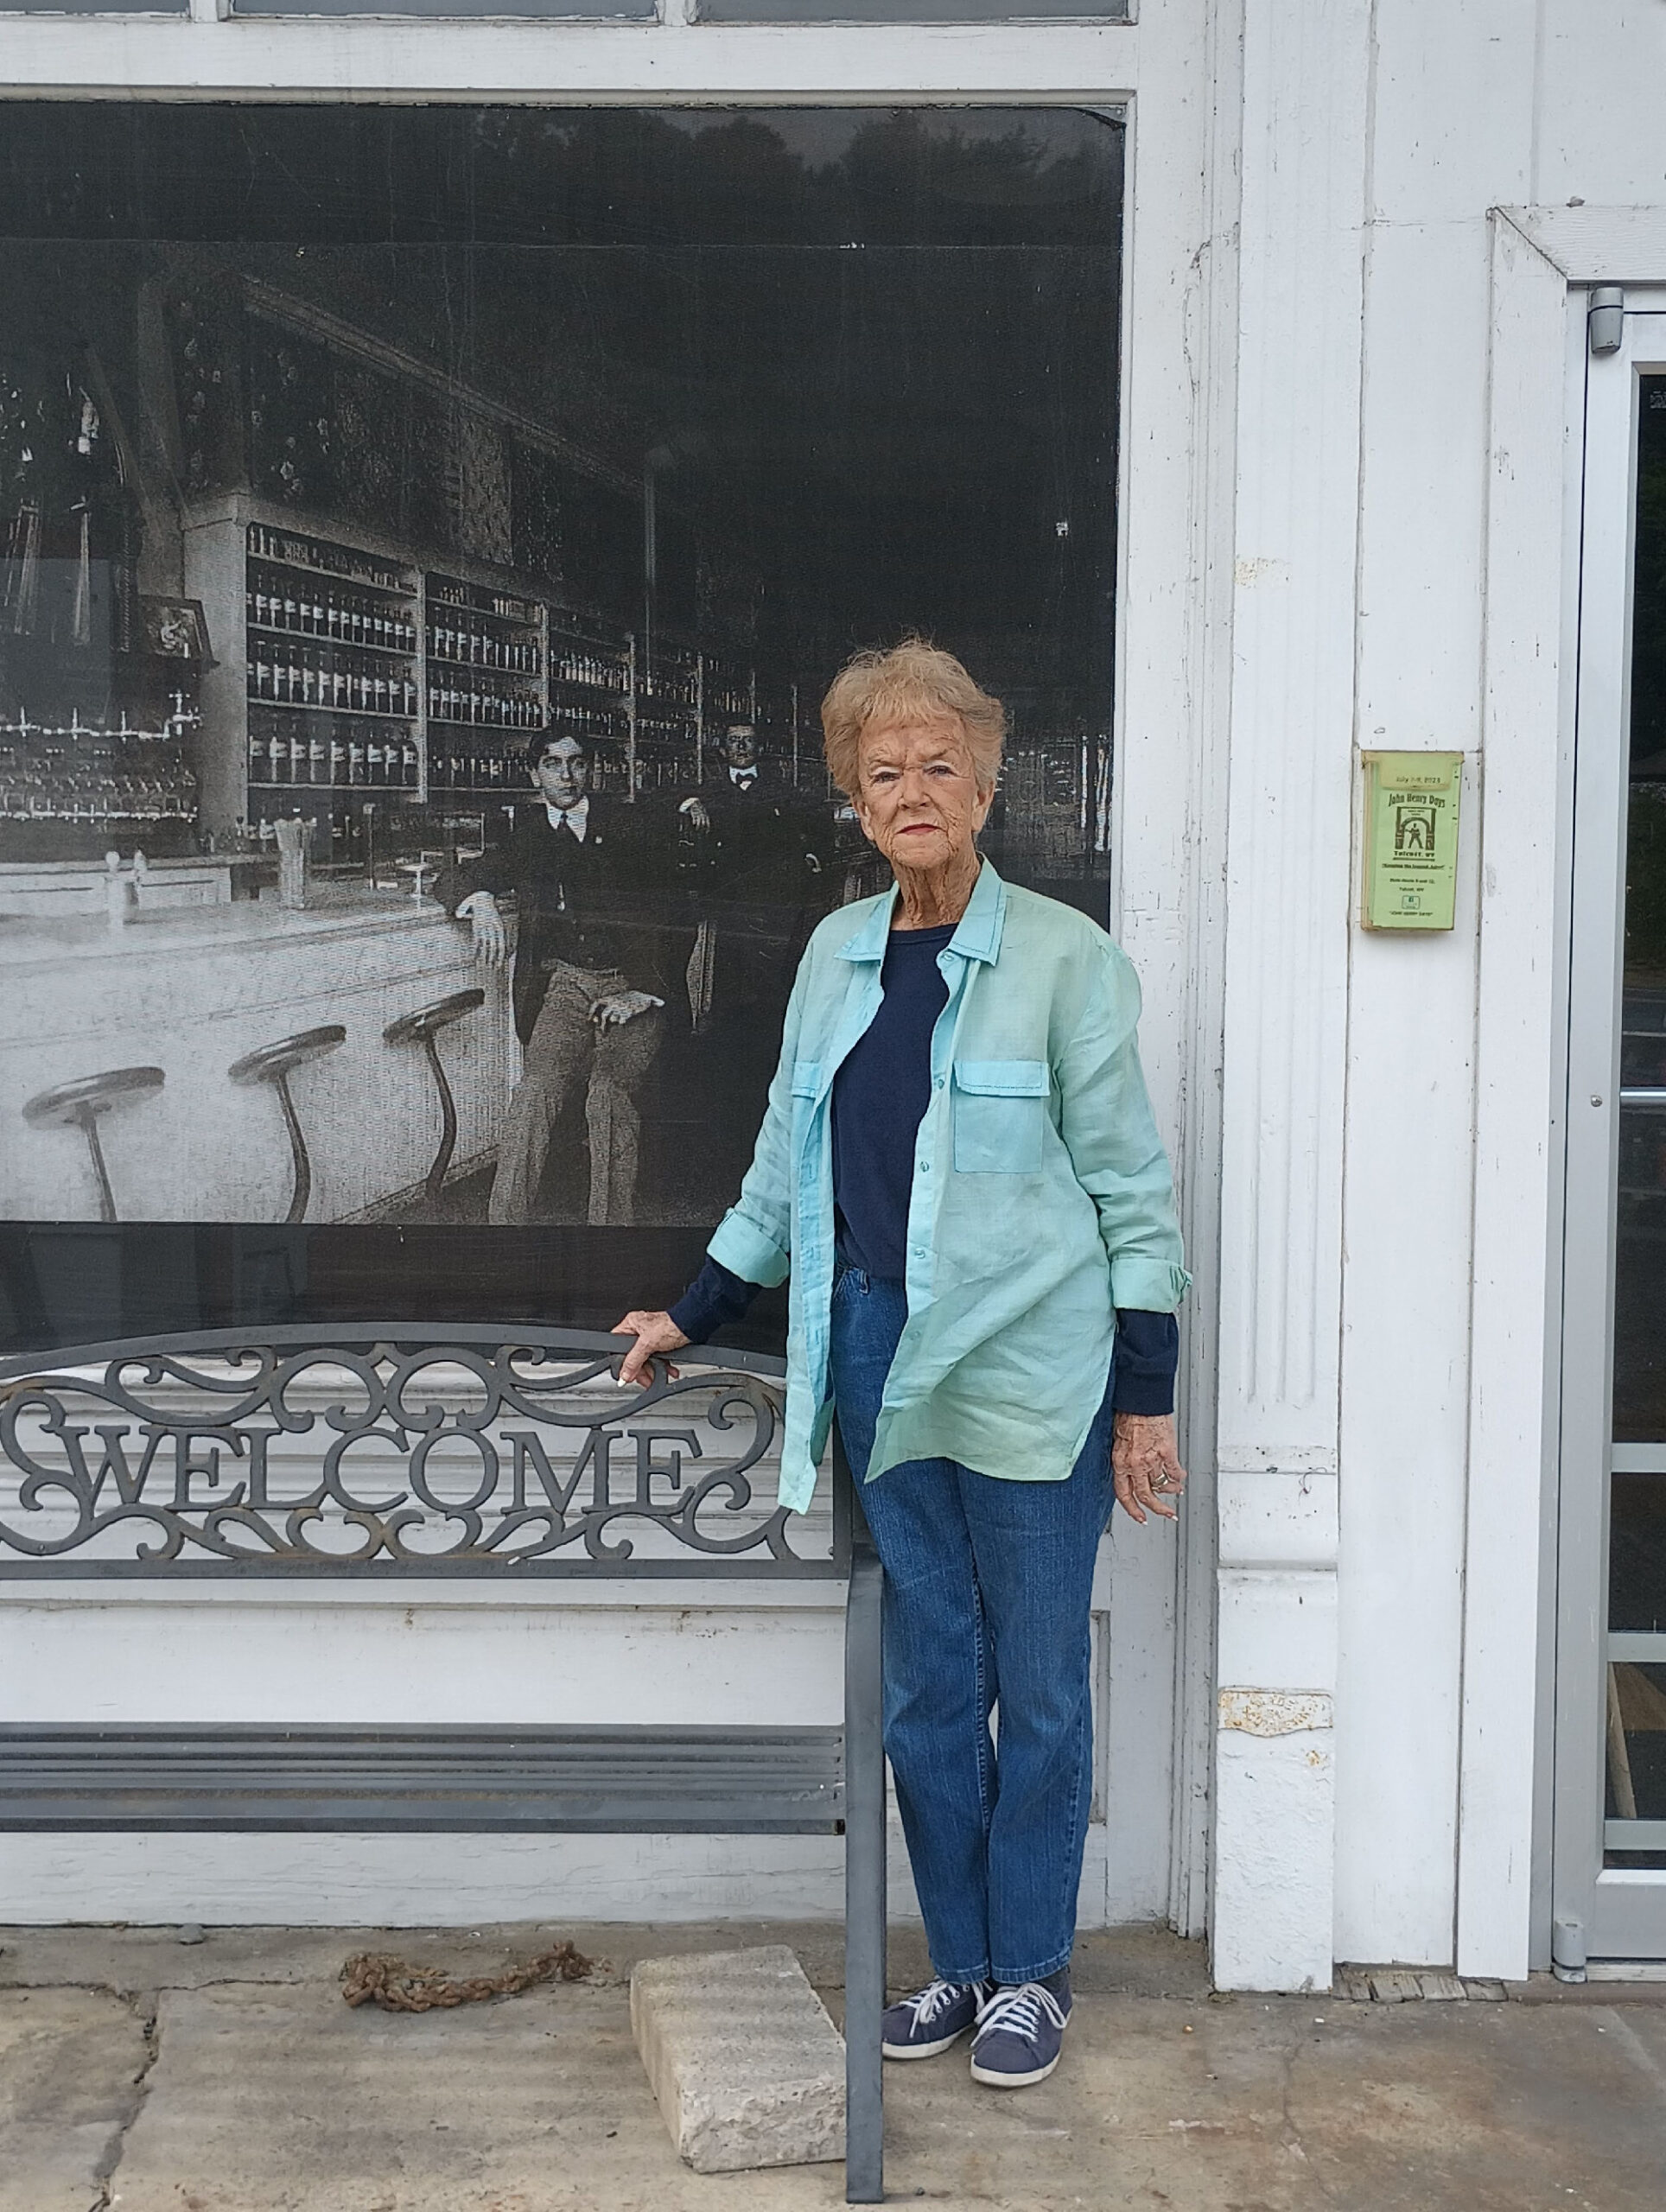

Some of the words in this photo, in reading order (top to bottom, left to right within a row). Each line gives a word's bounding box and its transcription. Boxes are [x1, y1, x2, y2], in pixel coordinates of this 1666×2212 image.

[1388, 793, 1405, 807] John
[1407, 793, 1427, 804] Henry
[1428, 795, 1446, 808] Days
[56, 1425, 702, 1515] WELCOME
